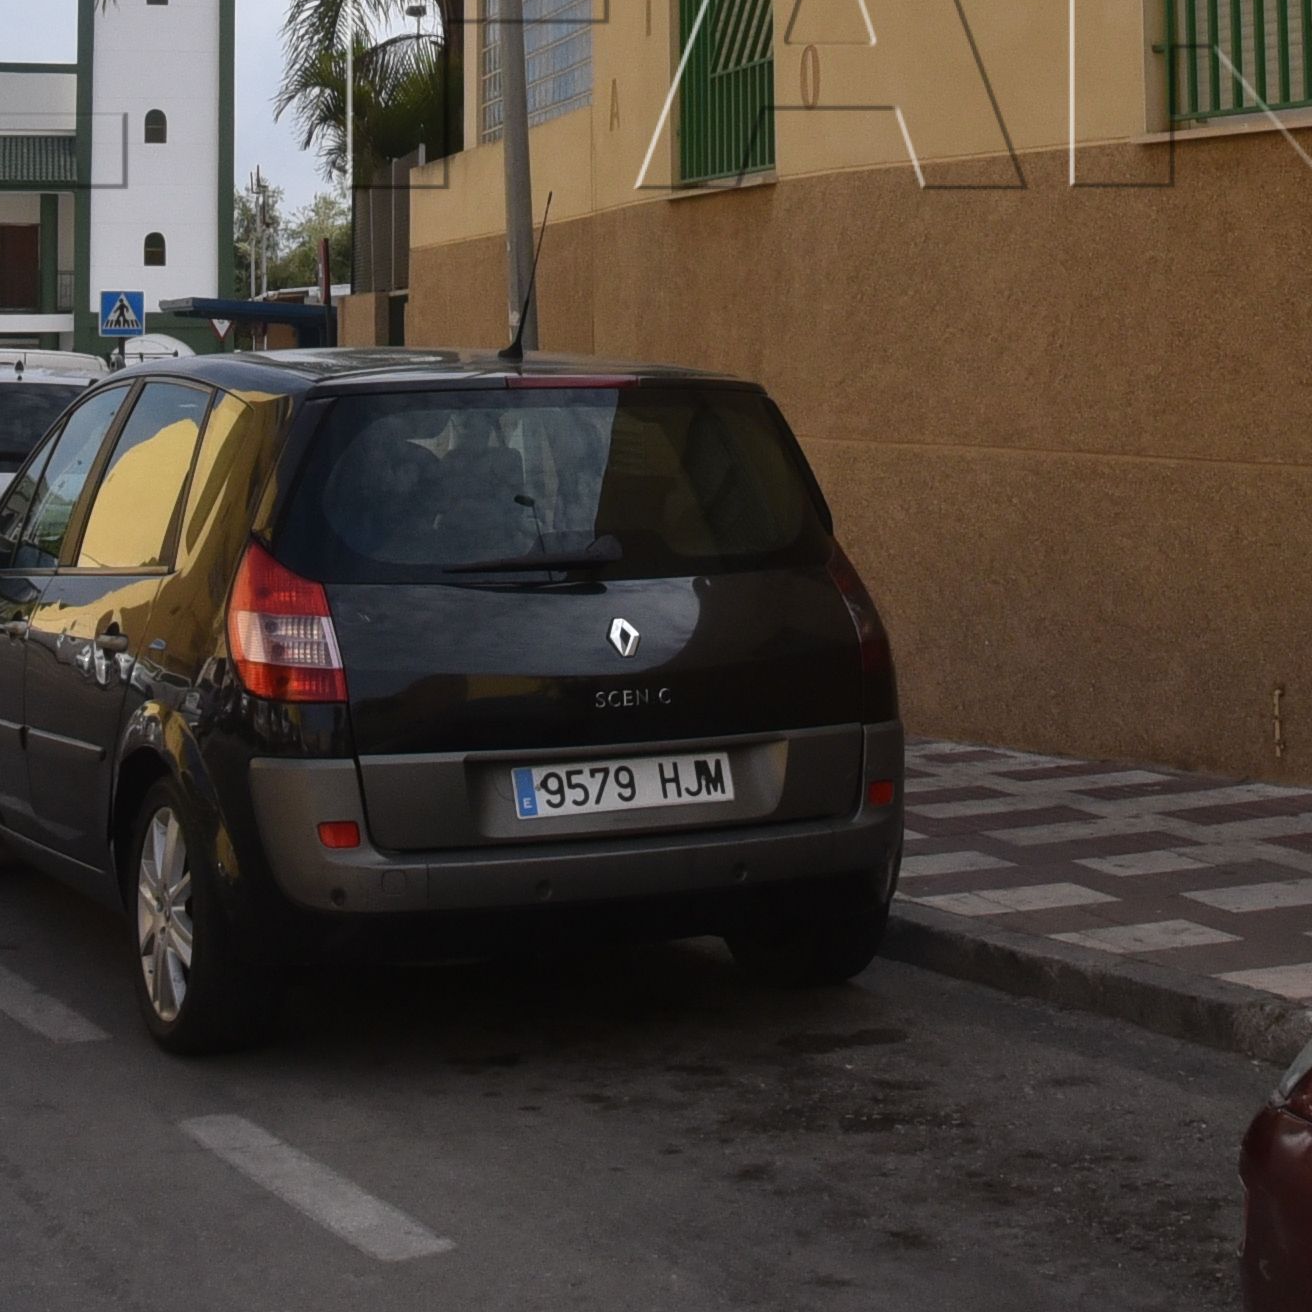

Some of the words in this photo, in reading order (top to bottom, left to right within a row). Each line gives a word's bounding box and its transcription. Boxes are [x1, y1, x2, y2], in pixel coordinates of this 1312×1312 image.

[595, 688, 672, 709] SCENC
[523, 797, 533, 809] E
[540, 765, 636, 809] 9579
[658, 758, 726, 800] HJM
